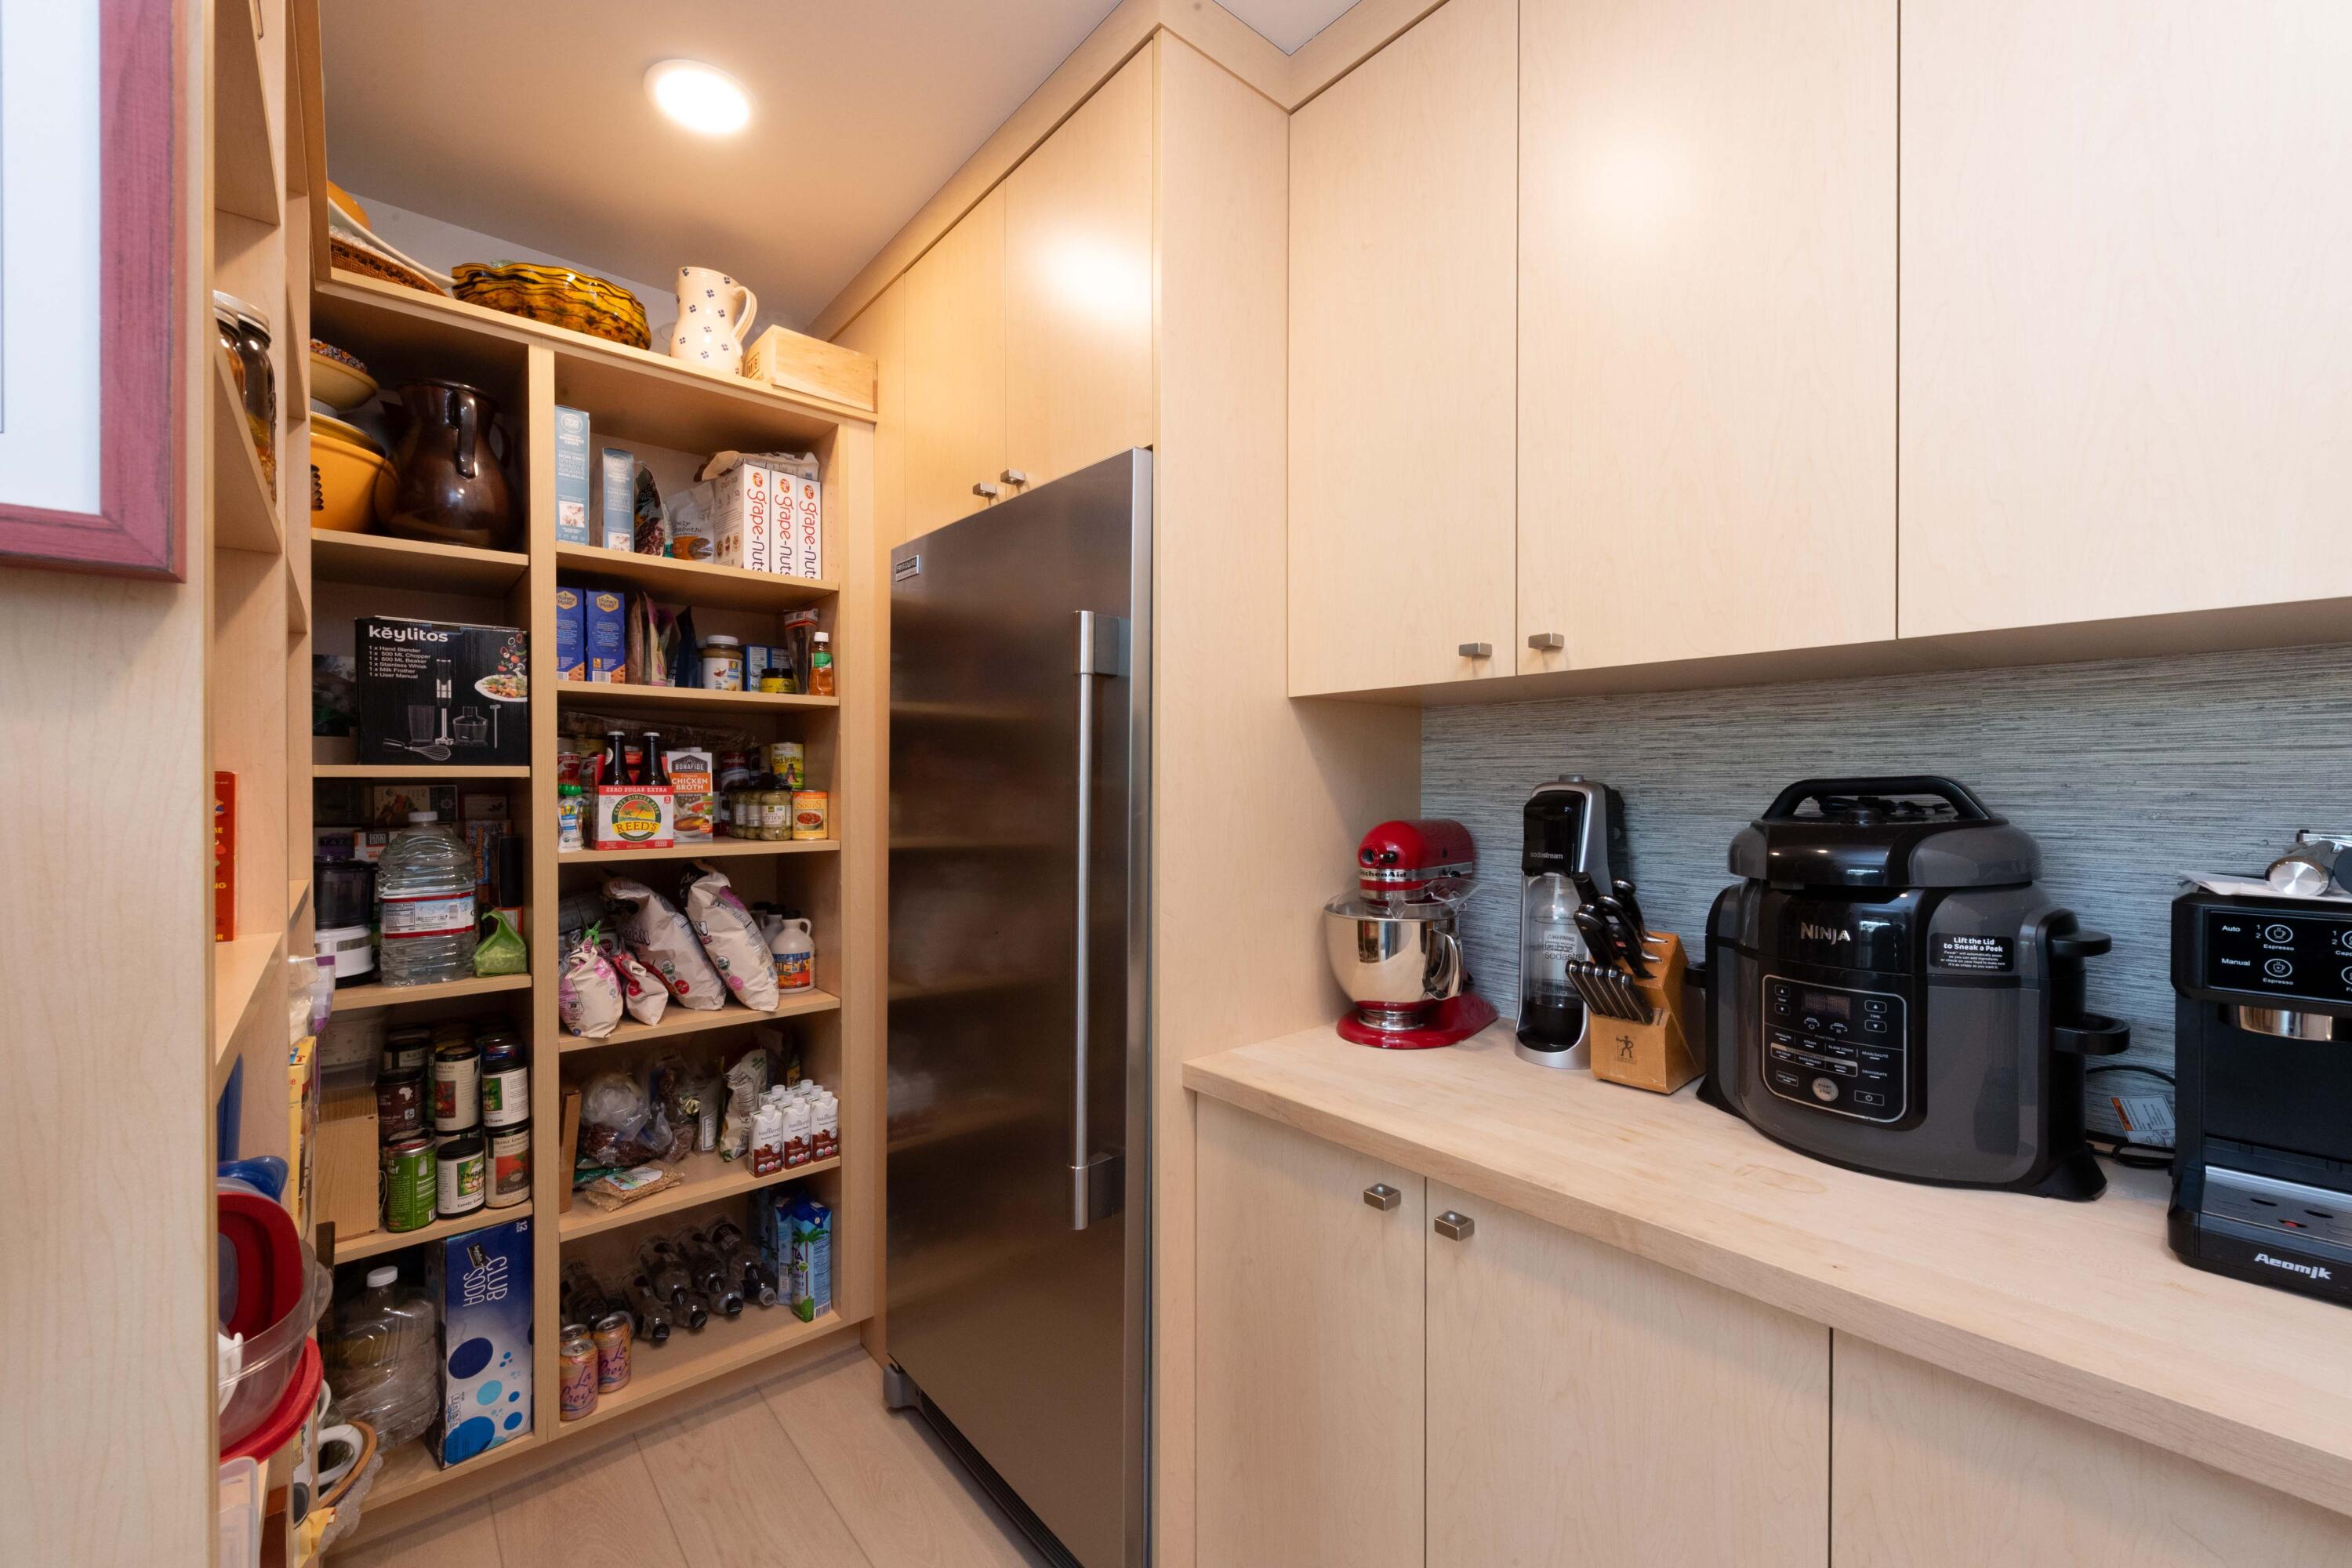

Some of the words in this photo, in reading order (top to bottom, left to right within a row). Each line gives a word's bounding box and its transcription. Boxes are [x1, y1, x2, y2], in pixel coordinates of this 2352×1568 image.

[799, 501, 818, 579] grape-nut
[614, 797, 626, 815] CRAFT
[651, 800, 660, 815] BEER
[616, 822, 658, 833] REED'S
[1801, 922, 1850, 945] NINJA
[1544, 952, 1585, 961] sodastre
[520, 1220, 528, 1231] 12
[2254, 1253, 2332, 1279] Aeomjk
[463, 1267, 485, 1307] SODA
[486, 1256, 508, 1301] CLUB
[612, 1338, 627, 1362] La
[573, 1366, 592, 1389] La
